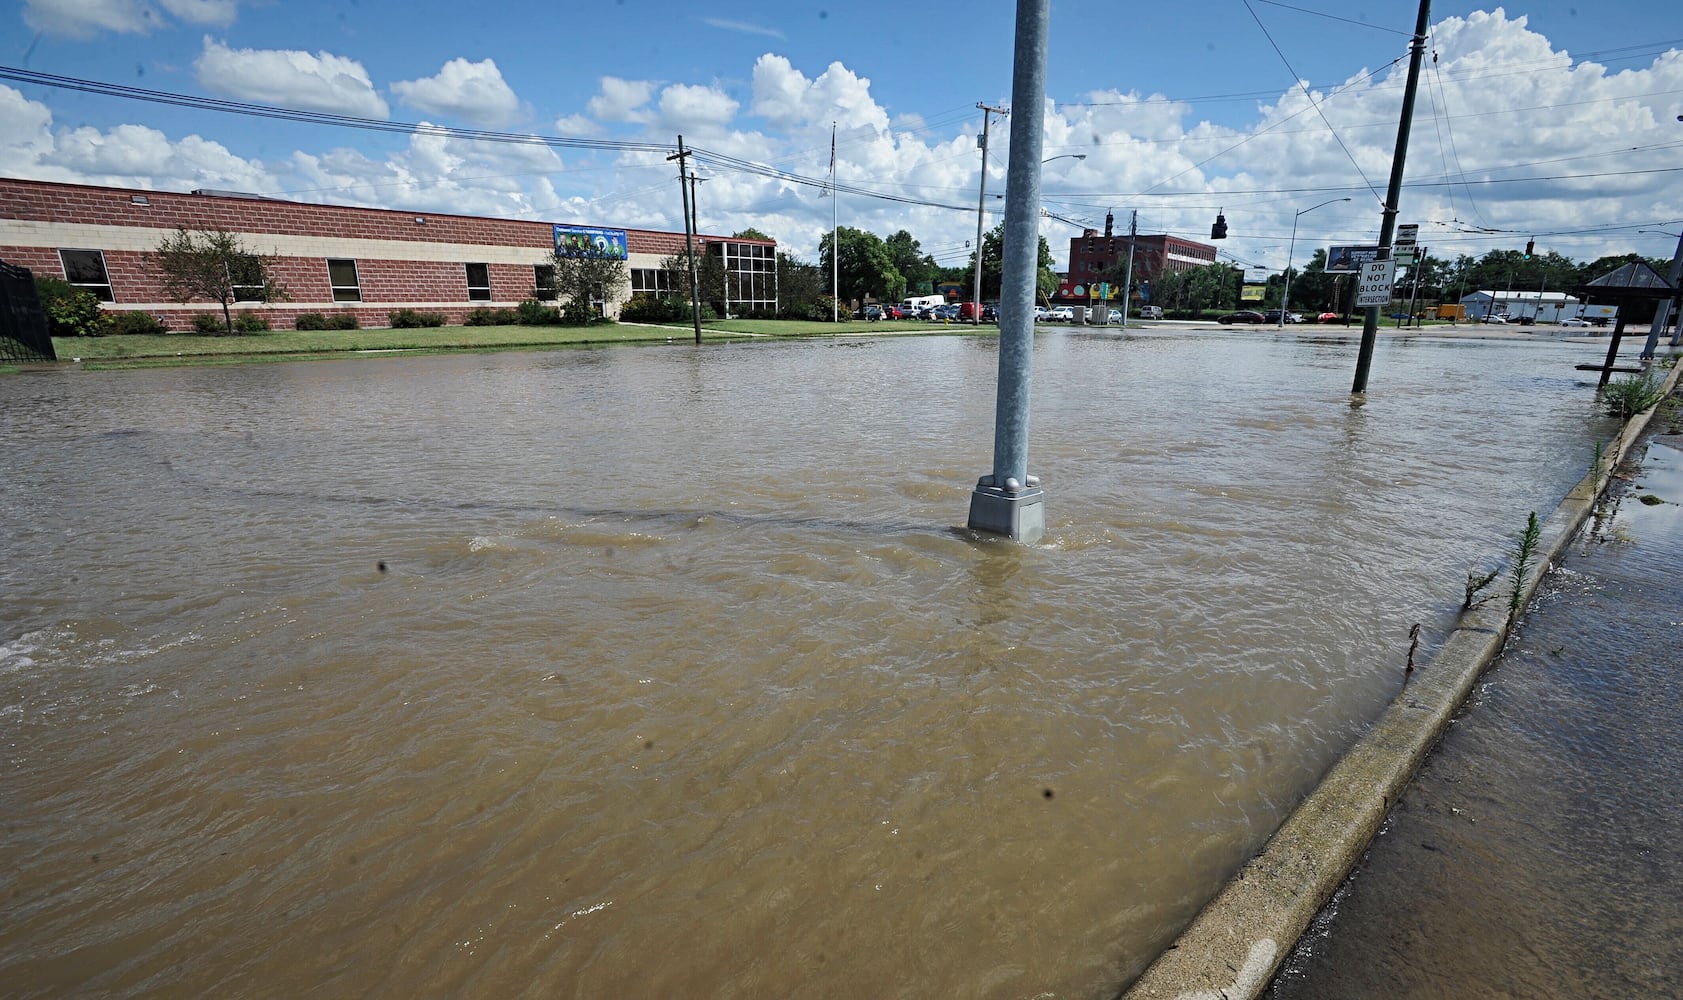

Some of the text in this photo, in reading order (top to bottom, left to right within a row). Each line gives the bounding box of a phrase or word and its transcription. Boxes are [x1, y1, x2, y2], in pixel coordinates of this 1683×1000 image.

[1366, 274, 1387, 282] NOT
[1360, 284, 1390, 292] BLOCK
[1359, 295, 1388, 303] INTERSECTION
